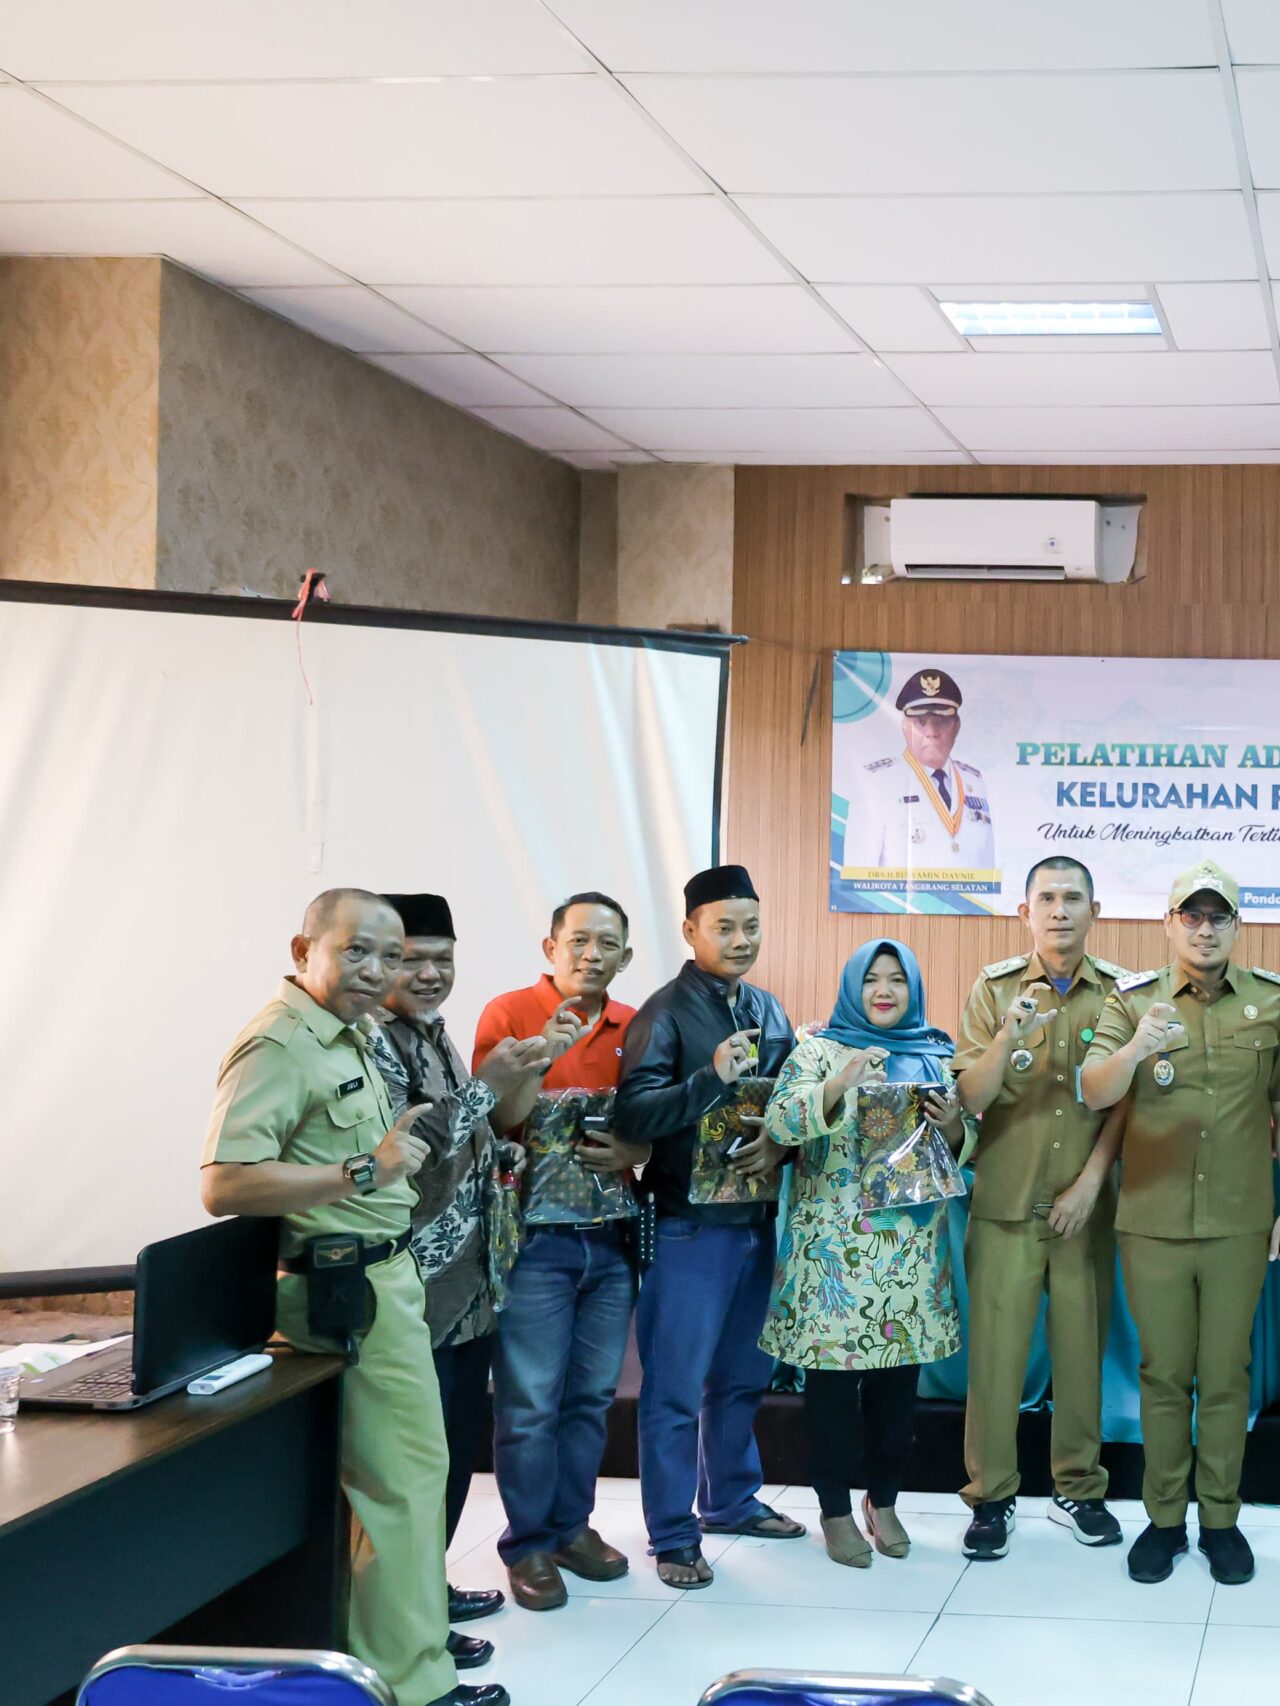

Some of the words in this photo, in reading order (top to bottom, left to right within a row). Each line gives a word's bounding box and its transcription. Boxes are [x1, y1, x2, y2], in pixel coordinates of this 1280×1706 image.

[1015, 742, 1229, 768] PELATIHAN
[1056, 781, 1259, 810] KELURAHAN
[1036, 822, 1098, 842] Untuk
[1100, 822, 1236, 848] Meningkatkan
[852, 881, 898, 890] WALIKOTA
[950, 883, 988, 892] SELATAN
